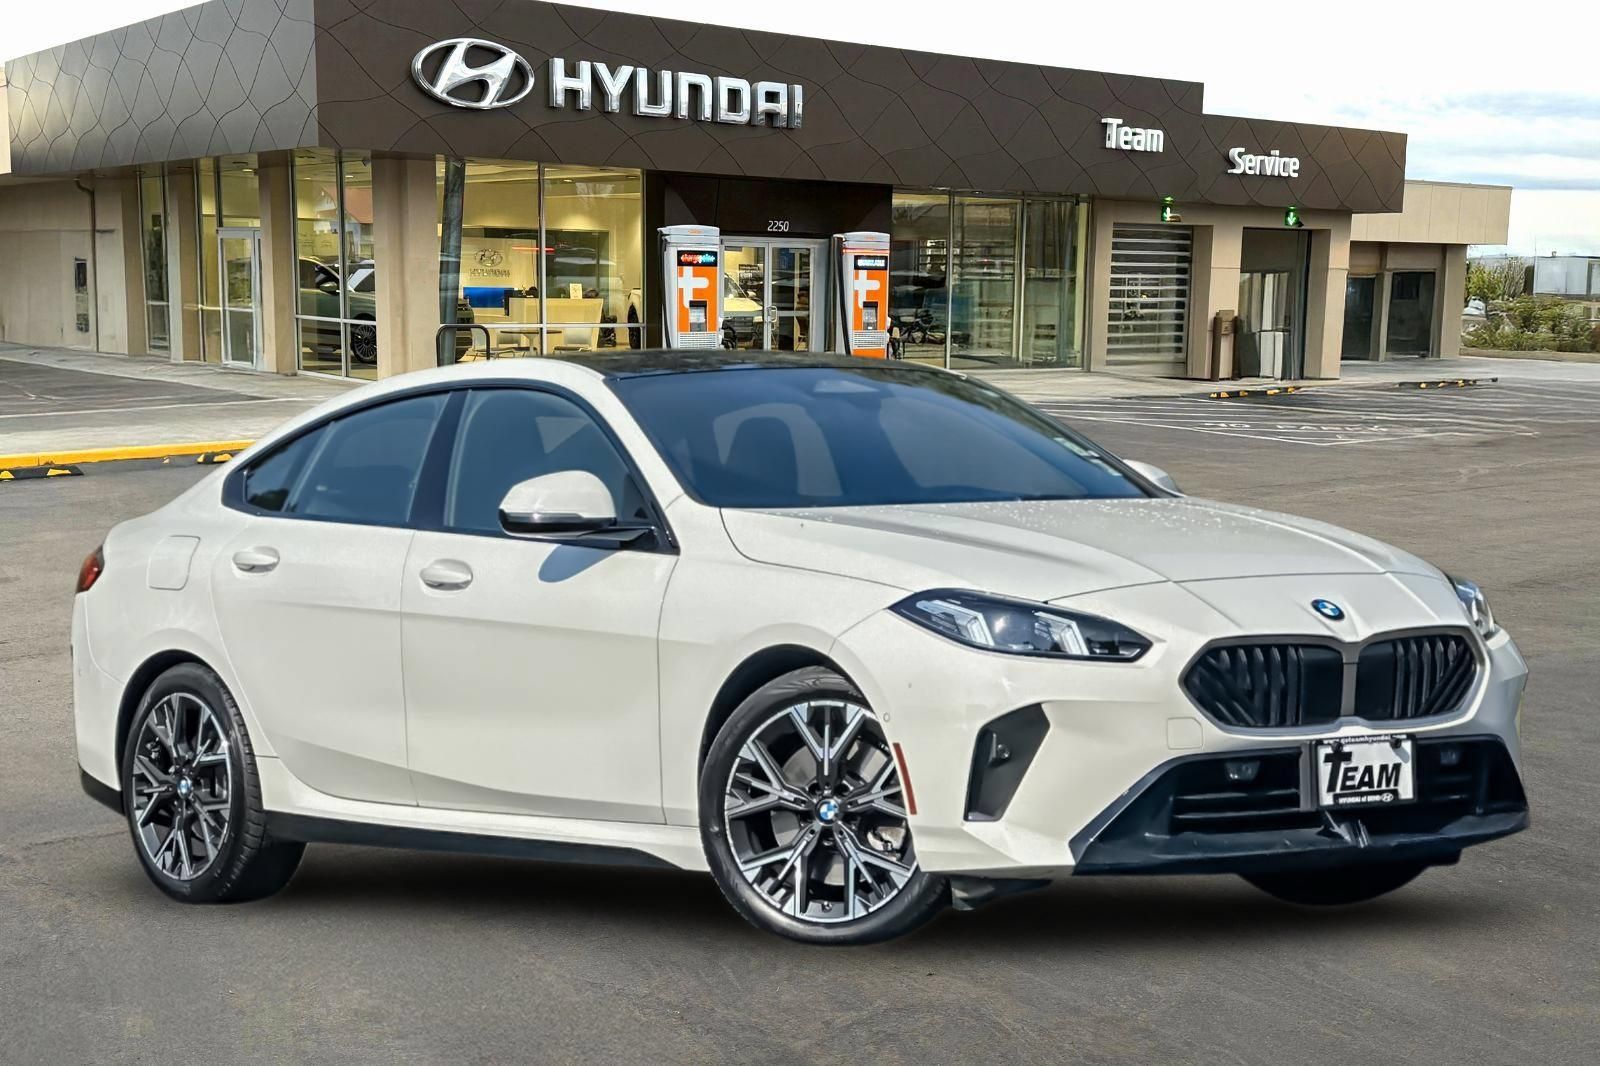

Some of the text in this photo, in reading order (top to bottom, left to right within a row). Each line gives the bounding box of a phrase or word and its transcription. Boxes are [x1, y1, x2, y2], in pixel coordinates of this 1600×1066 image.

[549, 57, 803, 129] HYUNDAI
[1101, 117, 1165, 153] Team
[1227, 147, 1301, 178] Service
[767, 220, 790, 232] 2250
[1323, 751, 1402, 793] TEAM
